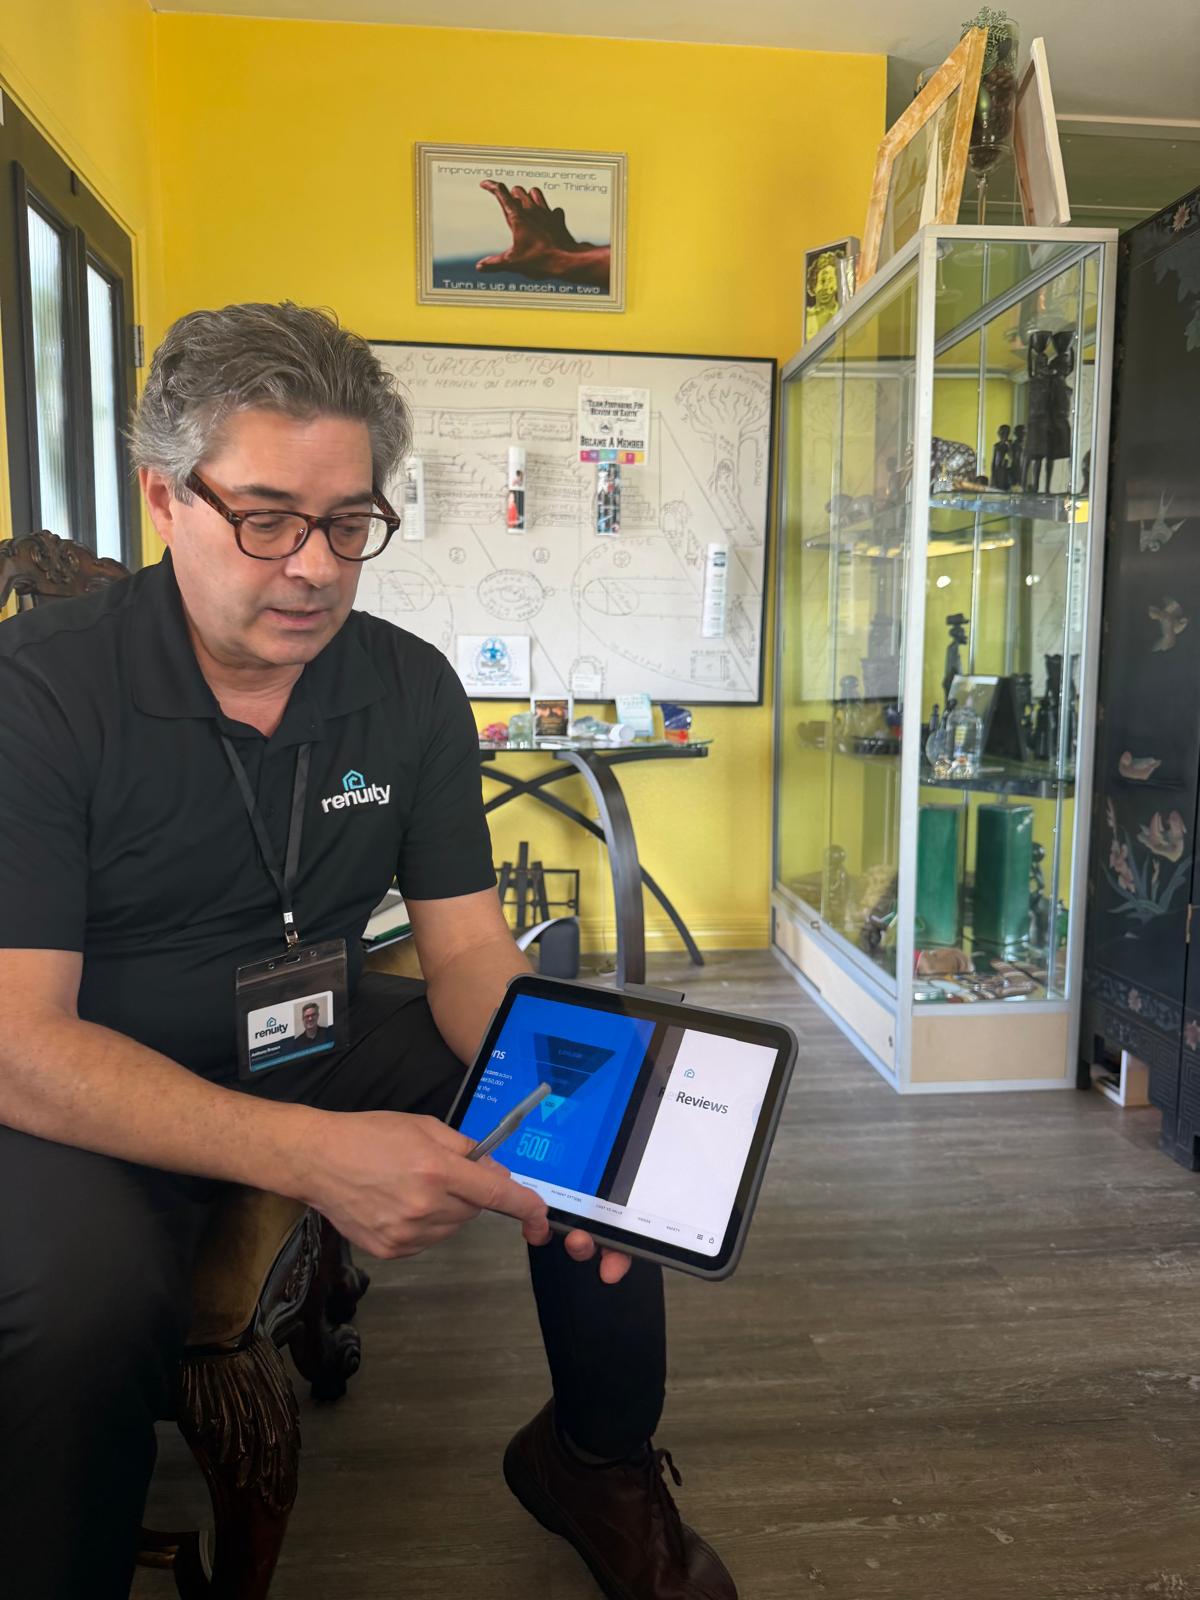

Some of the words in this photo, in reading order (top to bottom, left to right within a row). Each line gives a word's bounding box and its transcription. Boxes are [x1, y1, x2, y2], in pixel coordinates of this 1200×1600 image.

[437, 164, 494, 178] Improving
[494, 166, 515, 177] the
[516, 168, 598, 181] measurement
[543, 181, 560, 190] for
[563, 182, 609, 195] Thinking
[442, 279, 474, 289] Turn
[476, 280, 487, 290] it
[489, 282, 505, 293] up
[508, 282, 517, 291] a
[519, 281, 556, 293] notch
[558, 284, 574, 293] or
[576, 284, 601, 294] two
[526, 356, 596, 379] TEAM
[616, 437, 644, 449] MEMBER
[321, 783, 391, 813] renuity
[254, 1023, 289, 1039] renuity
[675, 1090, 729, 1115] Reviews
[516, 1132, 551, 1162] 500
